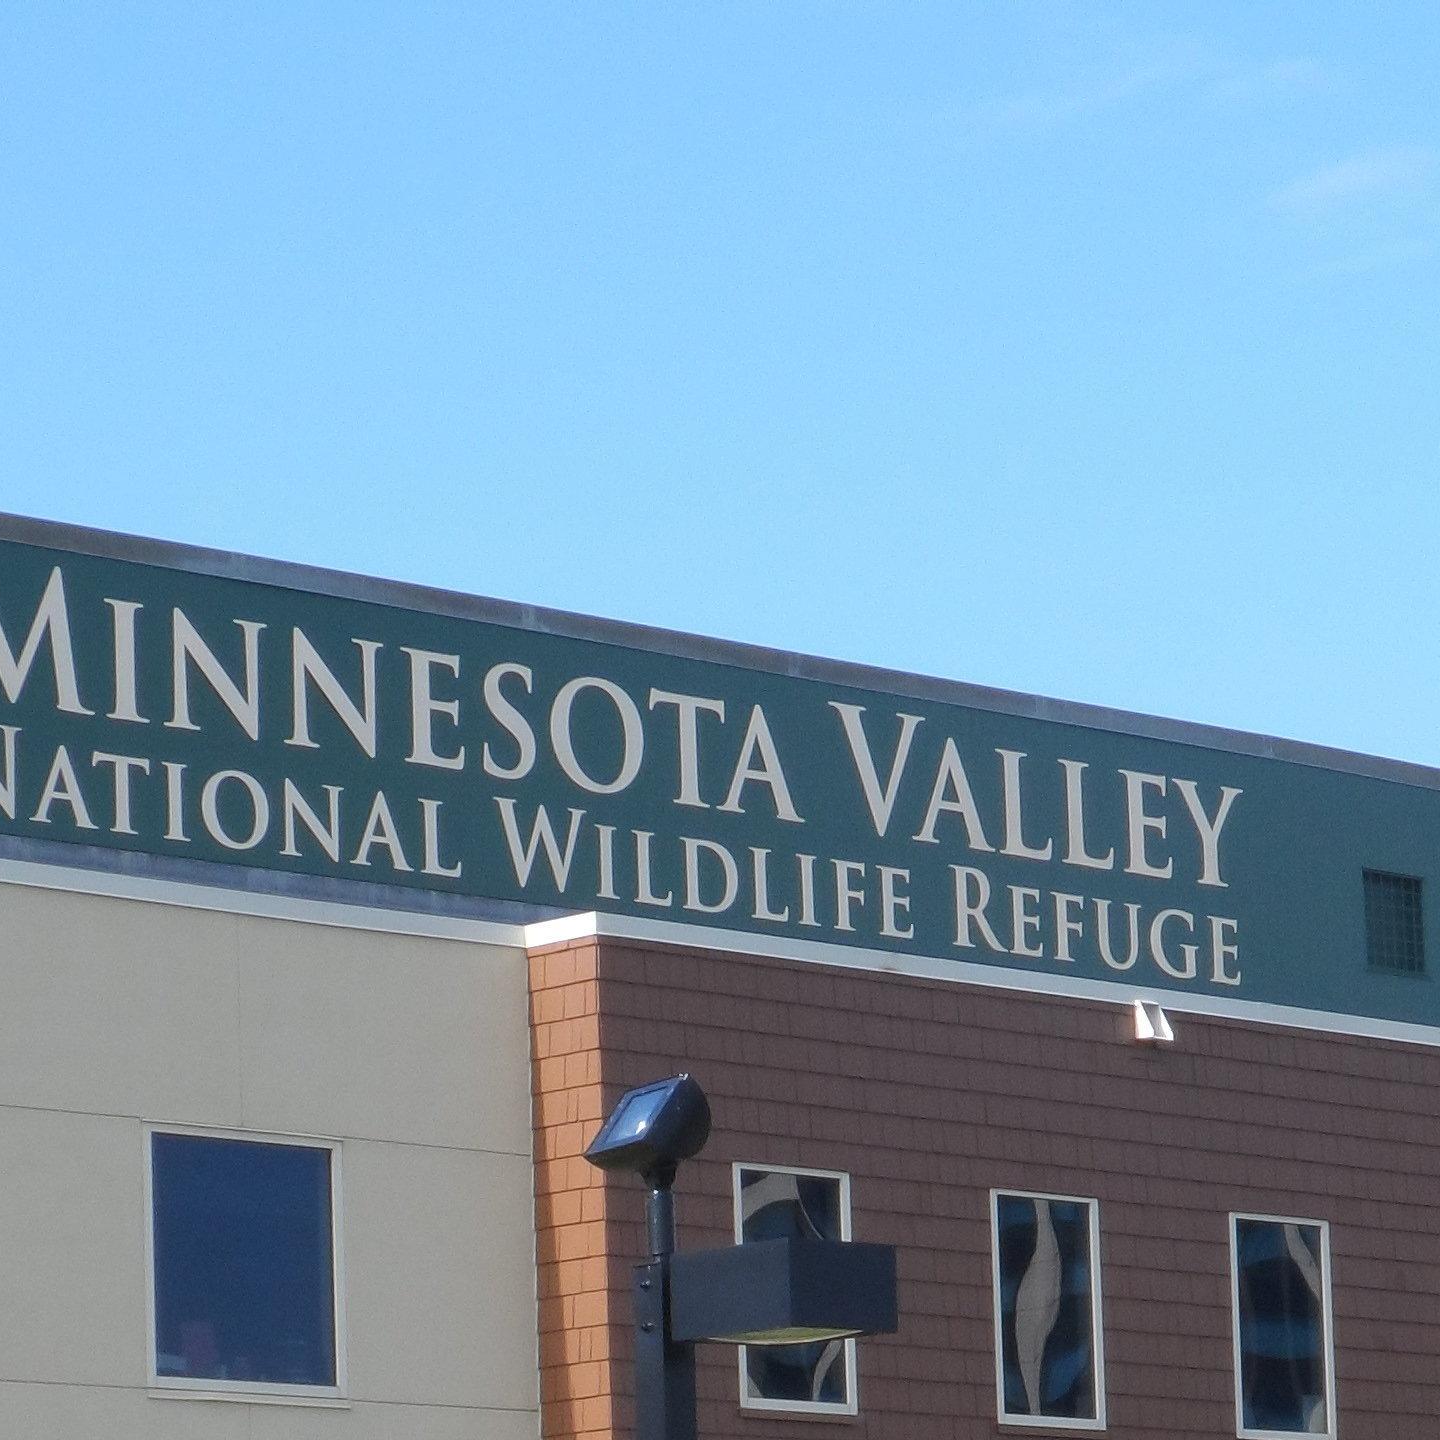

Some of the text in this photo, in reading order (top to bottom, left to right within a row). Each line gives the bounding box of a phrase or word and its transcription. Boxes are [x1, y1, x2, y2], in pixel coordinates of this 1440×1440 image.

[827, 700, 1244, 888] VALLEY
[492, 795, 915, 940] WILDLIFE
[948, 863, 1242, 986] REFUGE
